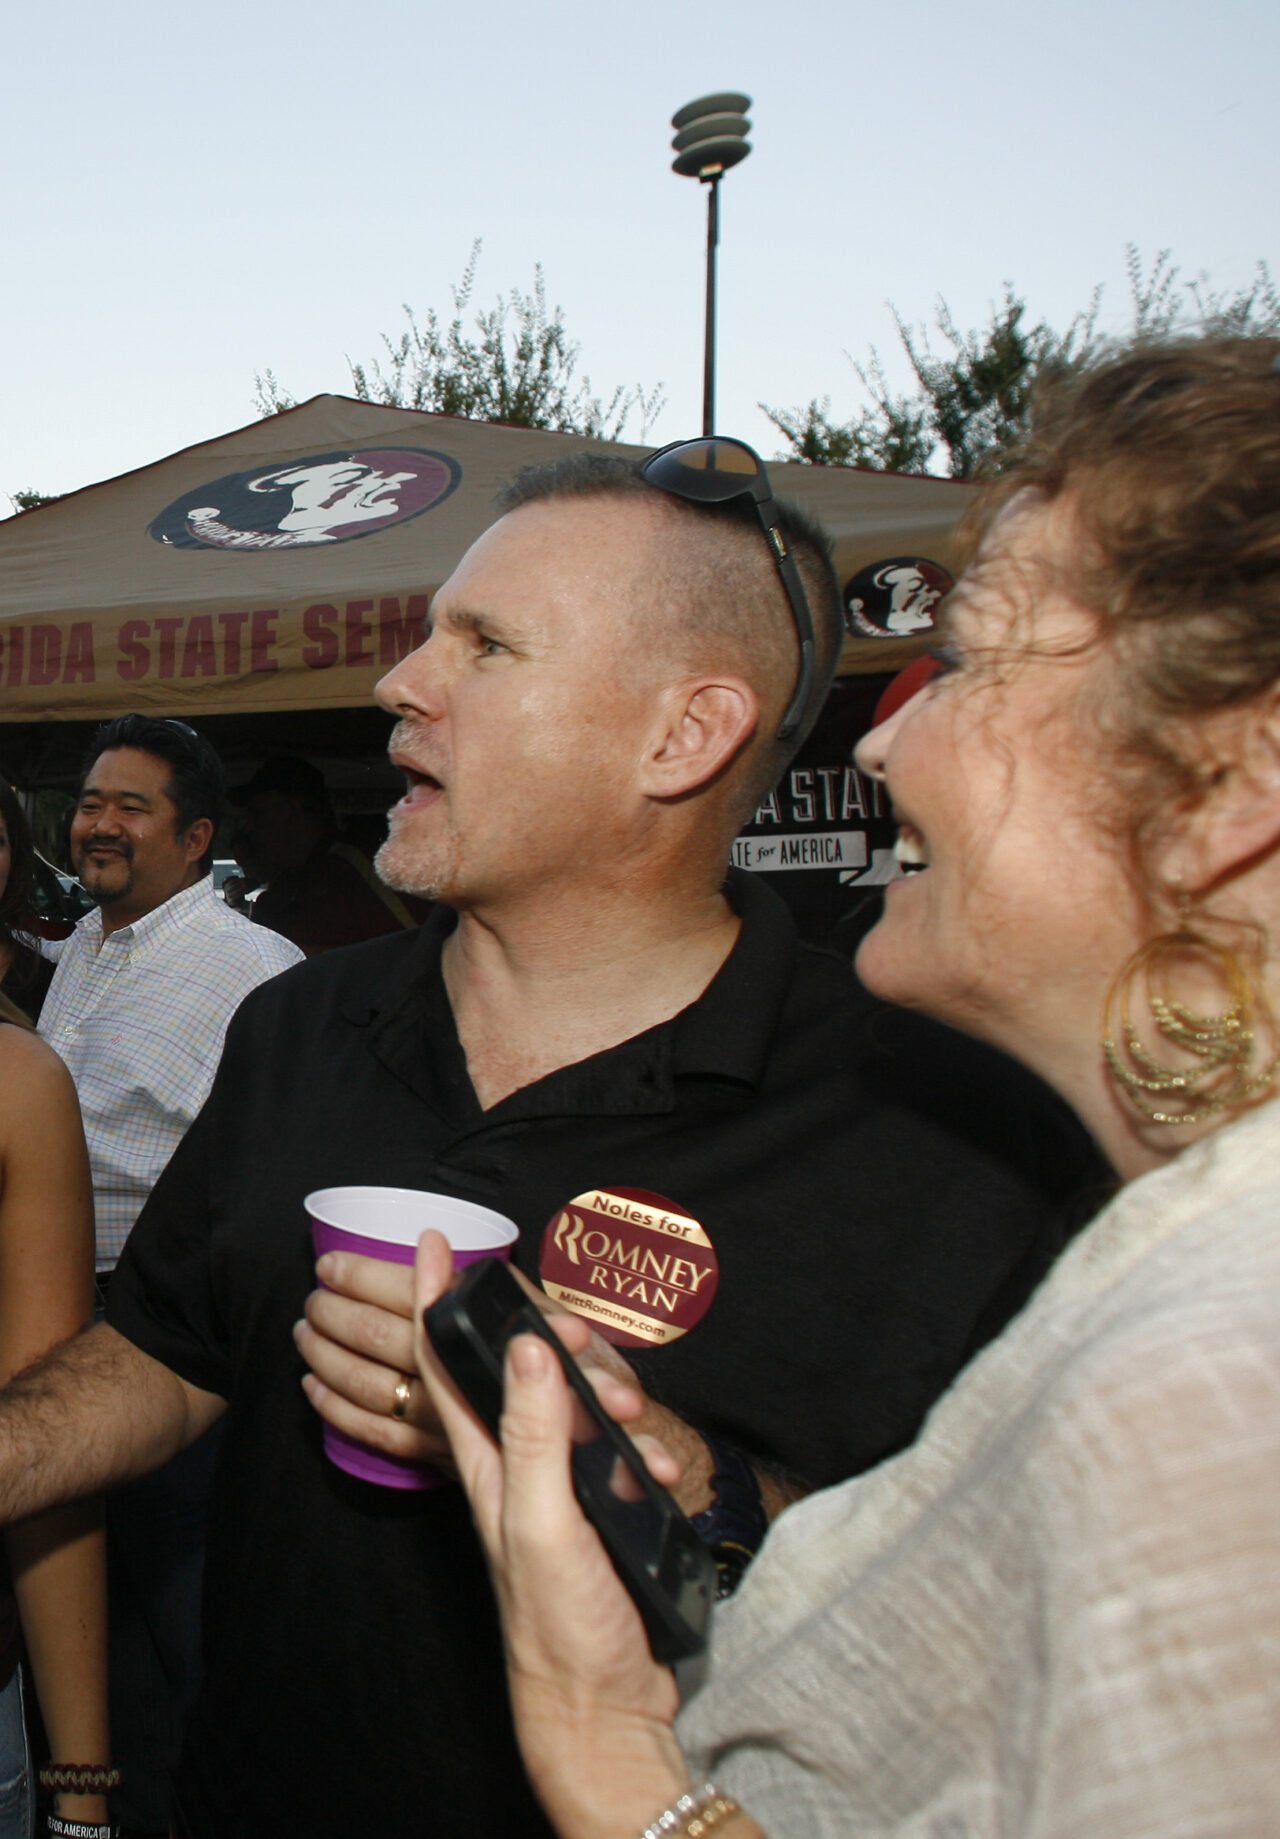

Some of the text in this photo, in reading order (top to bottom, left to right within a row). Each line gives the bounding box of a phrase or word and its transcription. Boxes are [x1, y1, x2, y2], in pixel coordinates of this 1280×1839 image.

[116, 609, 280, 681] STATE
[756, 846, 777, 863] for
[780, 836, 843, 866] AMERICA
[592, 1195, 693, 1238] Noles for
[553, 1211, 713, 1292] ROMNEY
[589, 1264, 679, 1313] RYAN
[558, 1290, 667, 1338] MittRomney.com
[63, 1823, 99, 1839] AMERICA
